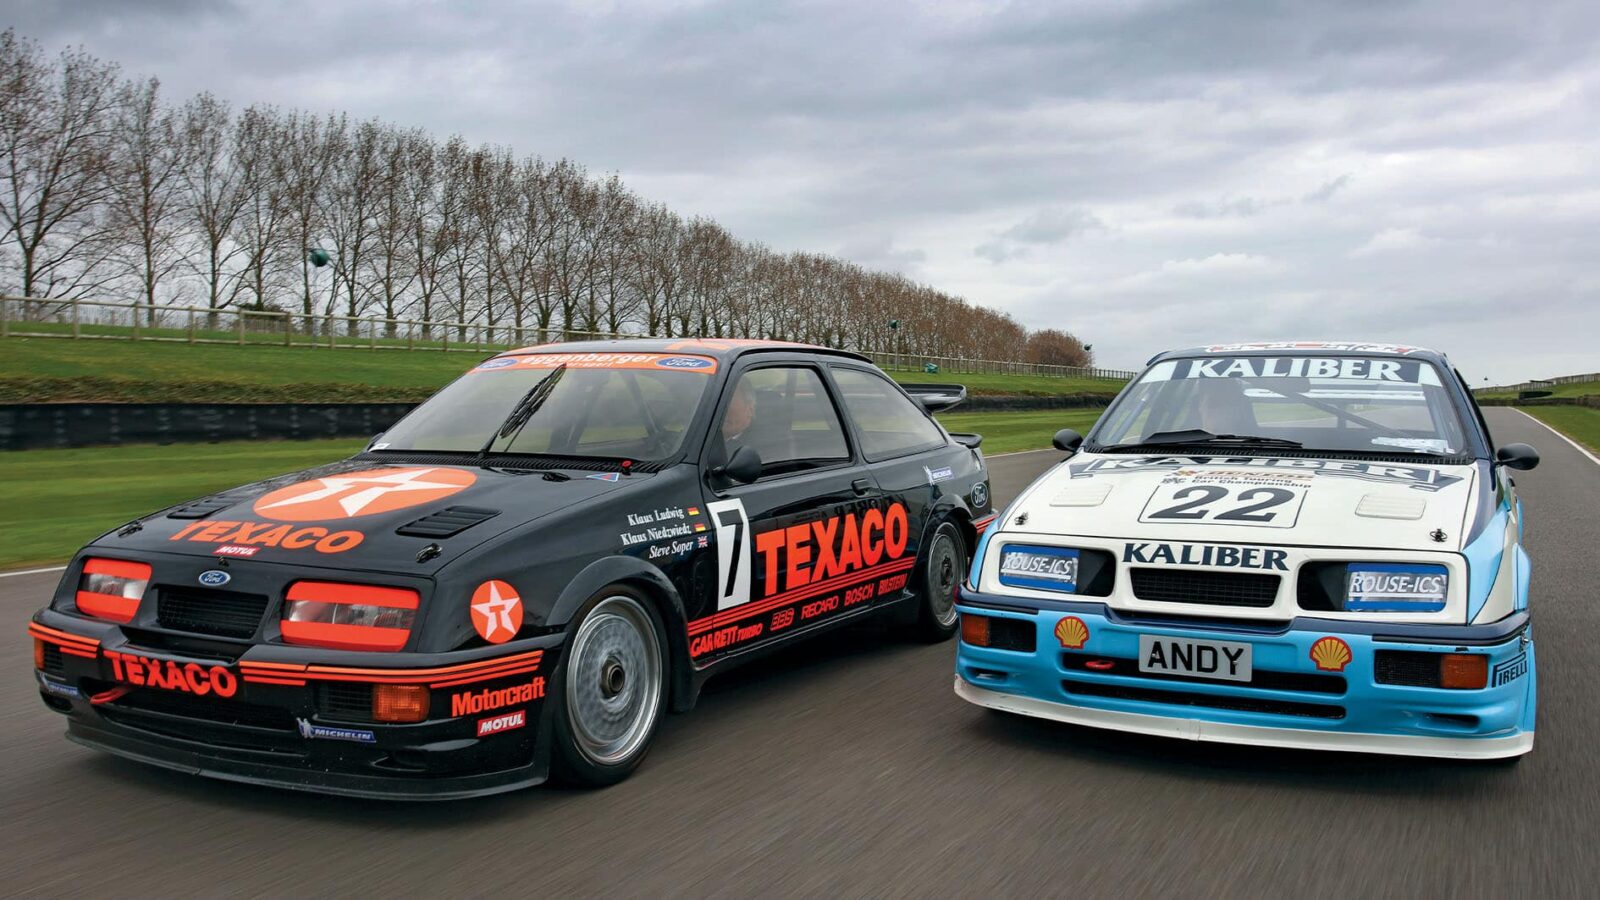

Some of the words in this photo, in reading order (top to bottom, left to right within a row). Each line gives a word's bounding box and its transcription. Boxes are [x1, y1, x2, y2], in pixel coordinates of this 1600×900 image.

[666, 357, 705, 368] Ford
[1186, 357, 1405, 382] KALIBER
[1097, 457, 1419, 481] KALIBER
[1219, 479, 1312, 488] Championship
[627, 513, 654, 526] Klaus
[654, 506, 685, 521] Ludwig
[1147, 485, 1296, 522] 22
[169, 519, 365, 553] TEXACO
[620, 533, 647, 546] Klaus
[647, 524, 692, 541] Niedzwiedz
[216, 545, 258, 556] MOTUL
[649, 545, 670, 559] Steve
[671, 540, 694, 556] Soper
[716, 508, 744, 598] 7
[756, 502, 909, 597] TEXACO
[1122, 542, 1290, 571] KALIBER
[1001, 552, 1073, 575] ROUSE-ICS
[844, 582, 875, 607] BOSCH
[1349, 575, 1441, 594] ROUSE-ICS
[801, 595, 840, 620] RECARO
[690, 625, 738, 659] GARRETT
[737, 622, 763, 641] TURBO
[1147, 641, 1245, 676] ANDY
[1491, 651, 1528, 688] PIRELLI
[103, 649, 238, 698] TEXACO
[451, 676, 546, 717] Motorcraft
[314, 728, 372, 740] MICHELIN
[480, 713, 525, 734] MOTUL
